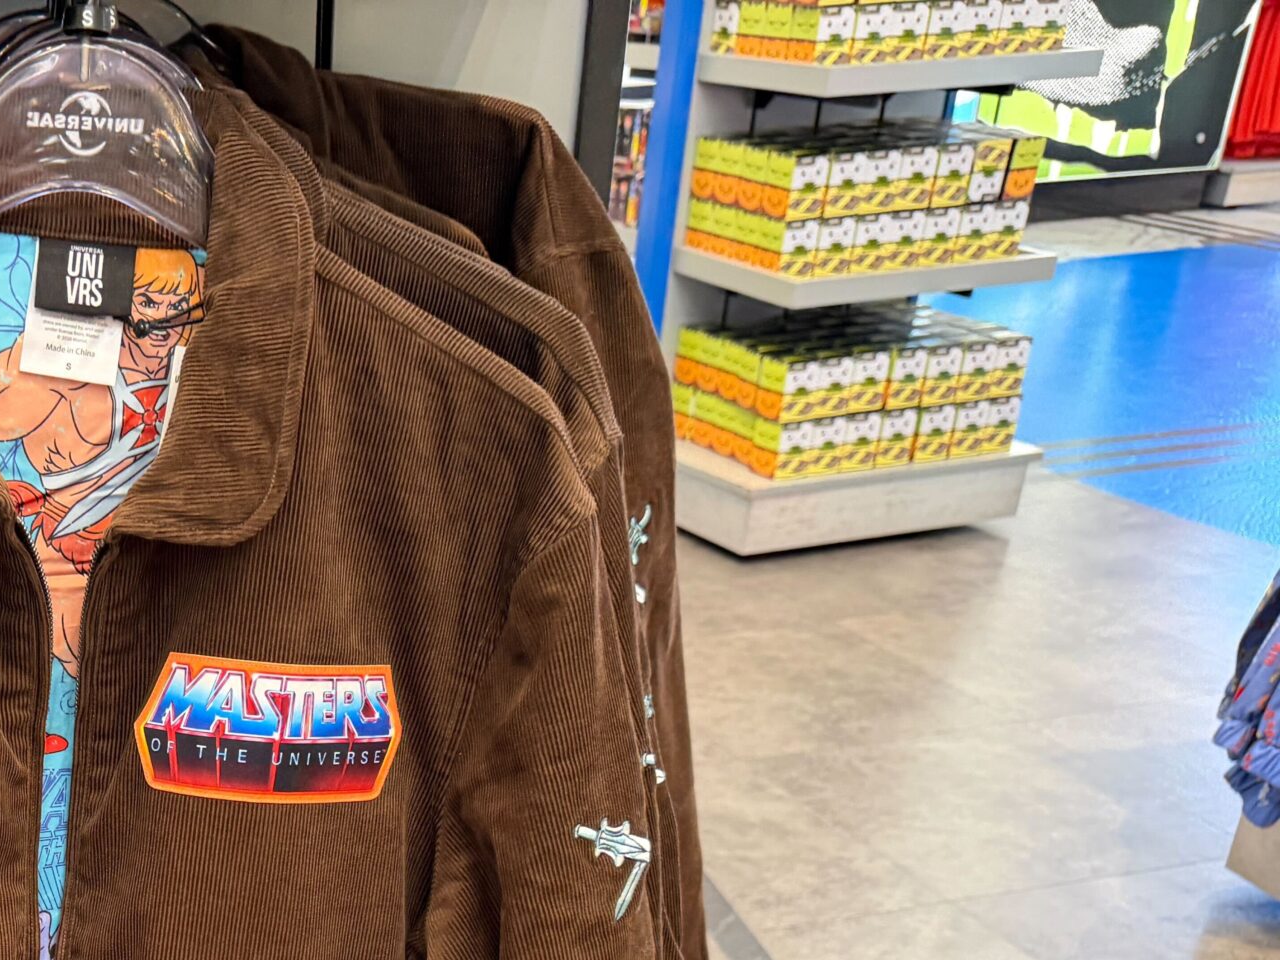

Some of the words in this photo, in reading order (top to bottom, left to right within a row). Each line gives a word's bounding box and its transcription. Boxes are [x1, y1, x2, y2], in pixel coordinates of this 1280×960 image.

[82, 9, 94, 28] S
[66, 250, 105, 279] UNI
[65, 275, 104, 308] VRS
[45, 343, 66, 353] Made
[66, 346, 74, 354] in
[75, 348, 96, 358] China
[65, 362, 72, 371] S
[146, 662, 395, 739] MASTERS
[150, 737, 174, 754] OF
[195, 744, 248, 764] THE
[272, 750, 382, 766] UNIVERSE
